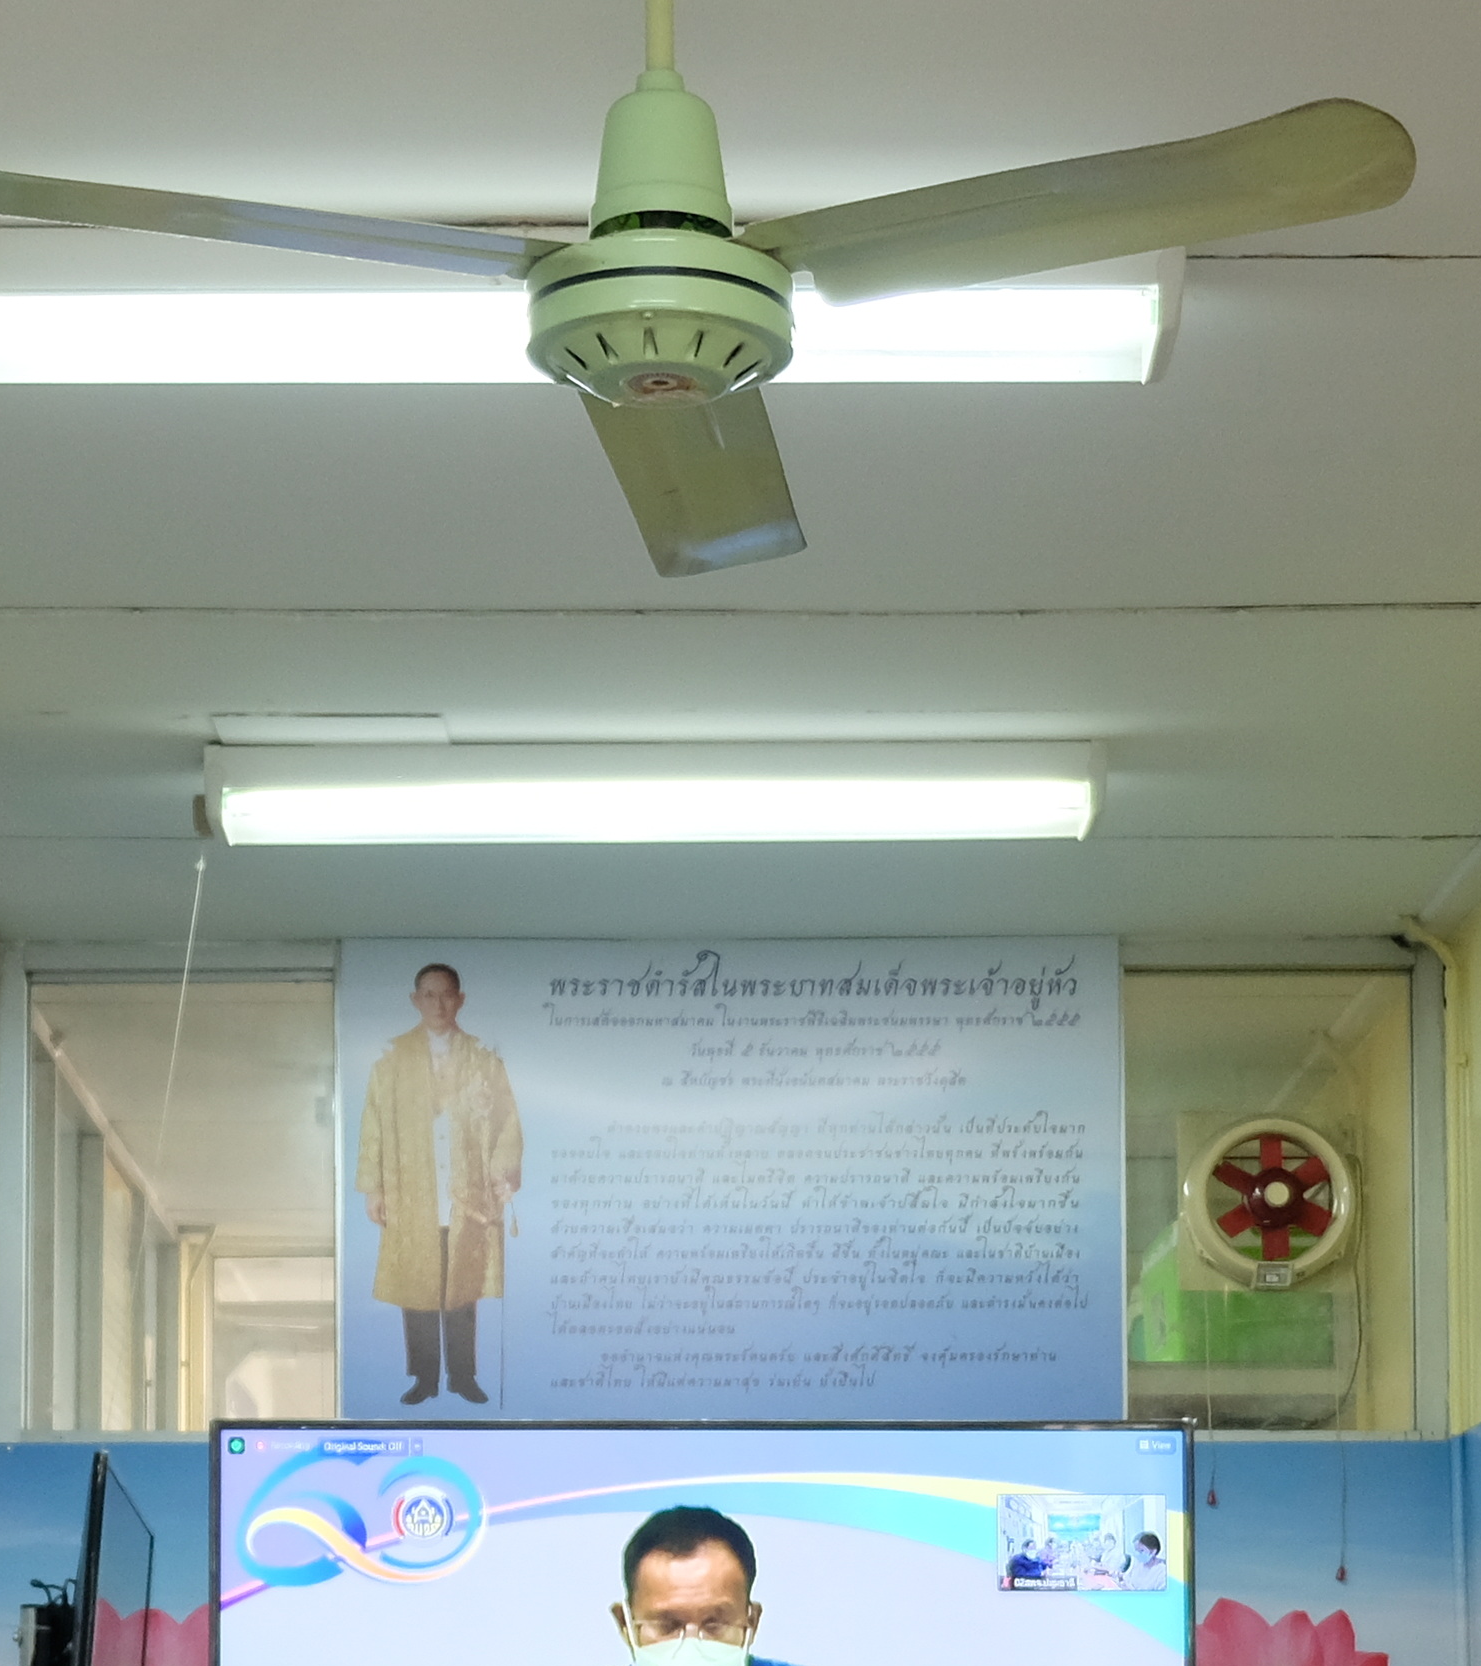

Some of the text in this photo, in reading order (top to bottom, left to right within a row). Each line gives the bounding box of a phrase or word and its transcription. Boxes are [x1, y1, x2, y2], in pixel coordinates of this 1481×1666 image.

[549, 950, 1078, 1011] พระราชดำรัสในพระบาทสมเด็จพระเจ้าอยู่หัว
[323, 1441, 357, 1453] Original
[357, 1441, 387, 1452] Sound:
